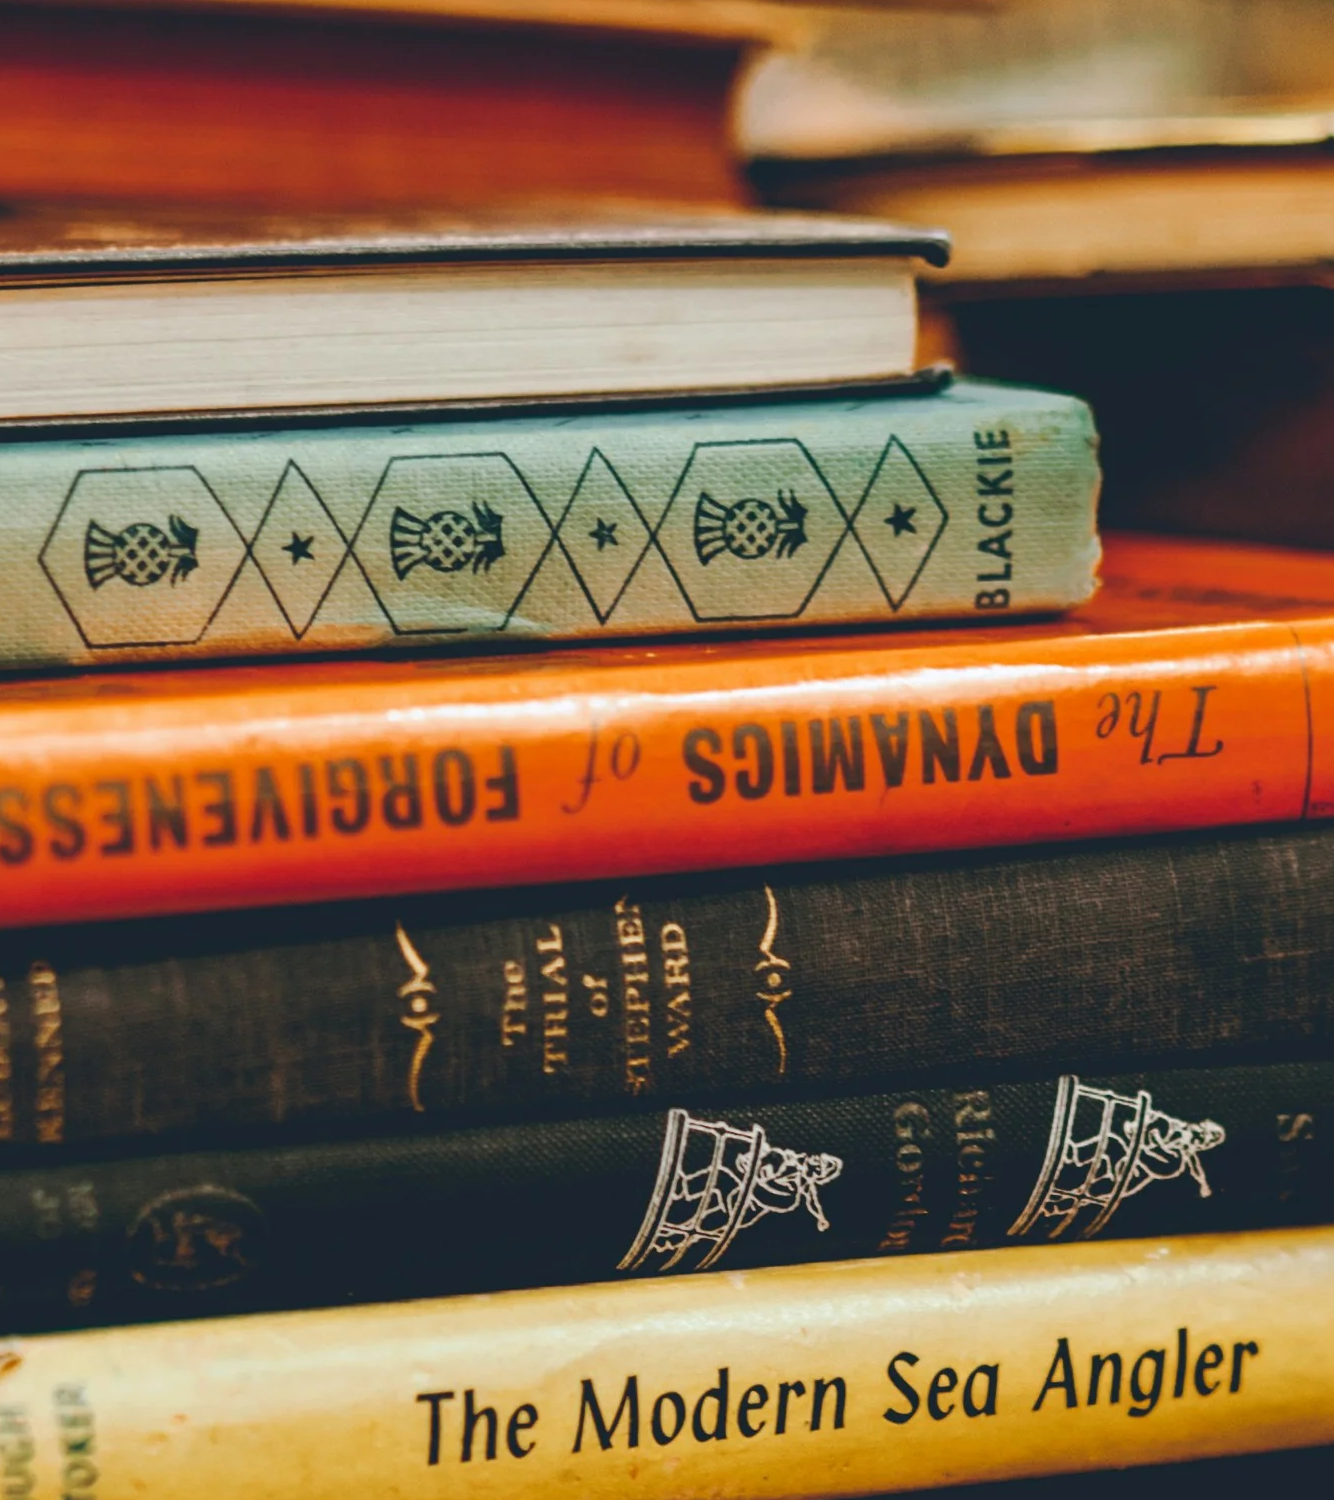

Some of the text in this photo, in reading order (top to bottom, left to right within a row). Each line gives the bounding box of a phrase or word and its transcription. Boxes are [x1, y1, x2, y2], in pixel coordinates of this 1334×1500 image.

[974, 426, 1016, 612] BLACKIE
[560, 718, 643, 815] of
[680, 699, 1060, 807] DYNAMICS
[1093, 682, 1225, 767] The
[500, 960, 529, 1046] The
[536, 924, 570, 1075] TRIAL
[581, 973, 610, 1018] of
[659, 921, 692, 1059] WARD
[415, 1328, 1261, 1467] The Modern Sea Angler
